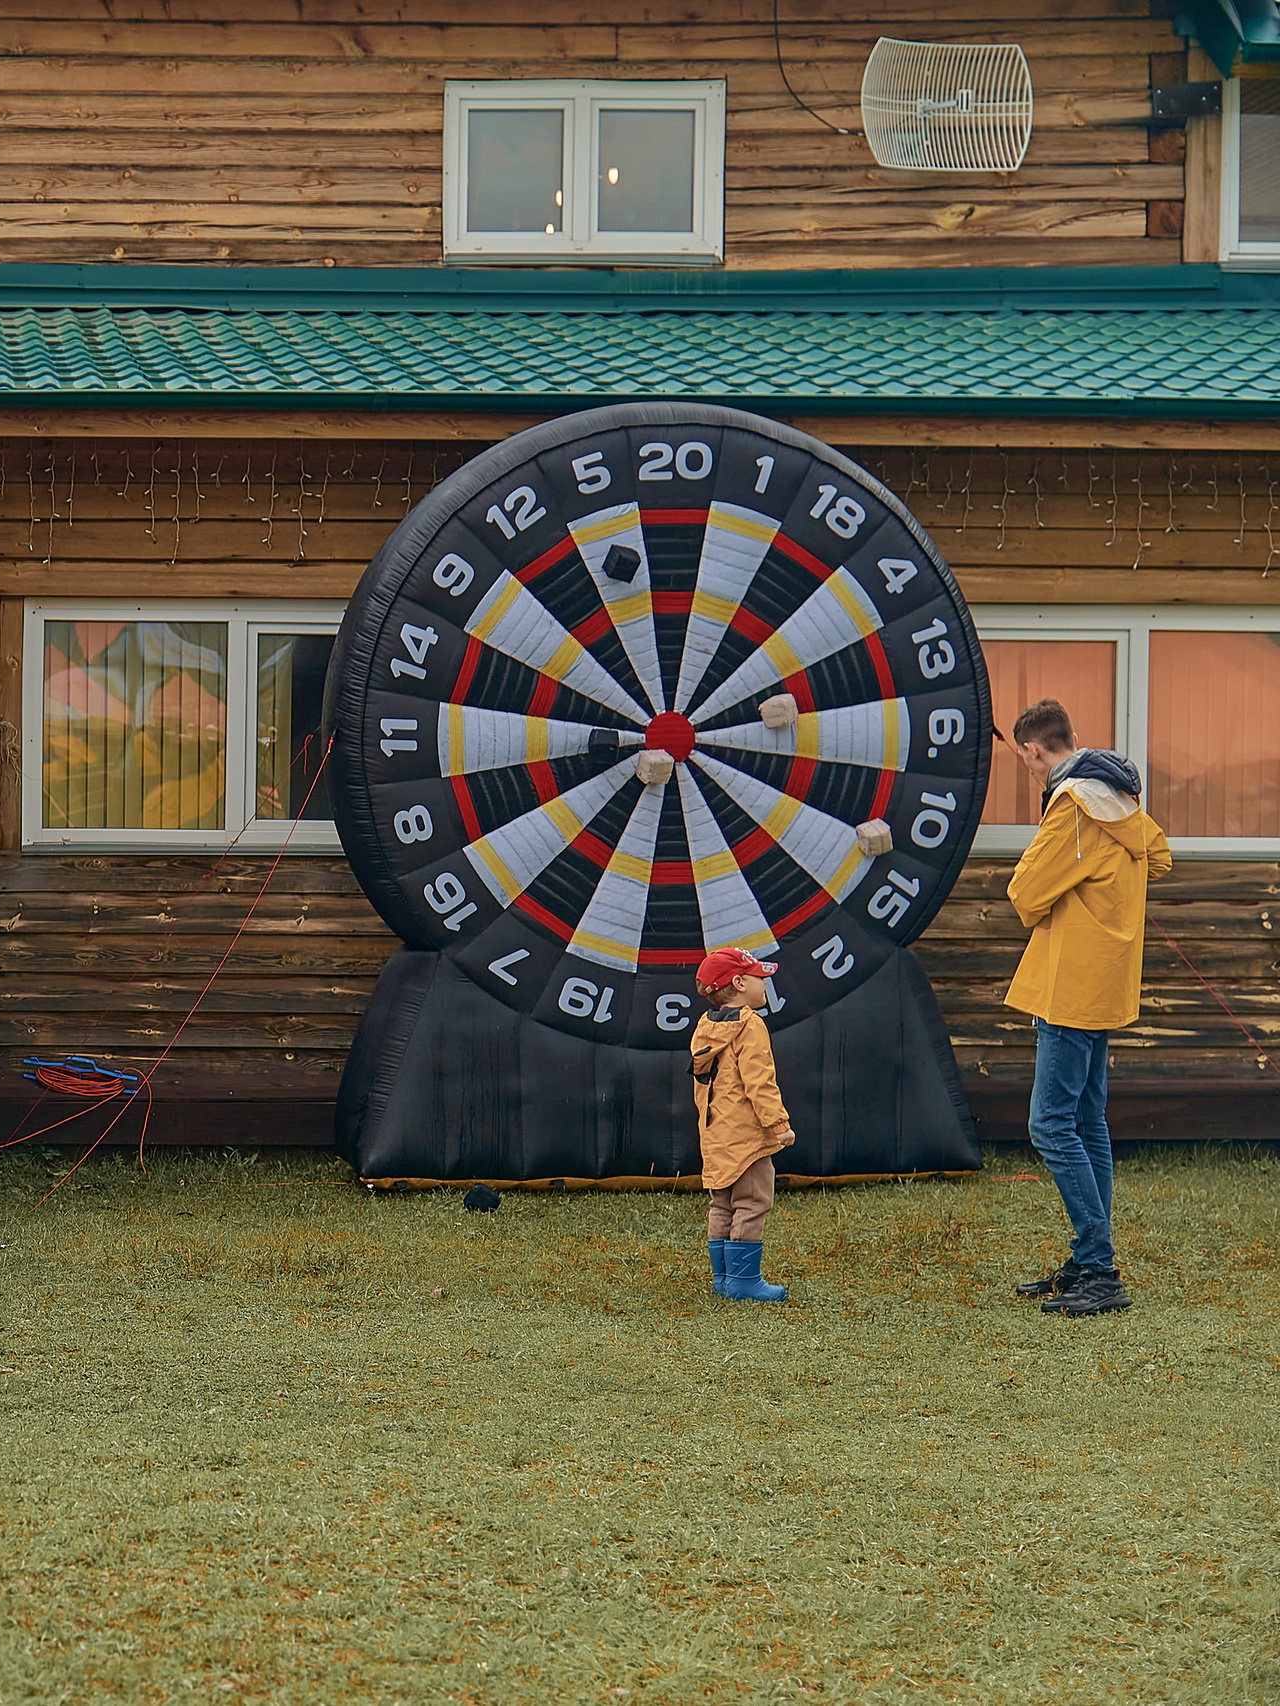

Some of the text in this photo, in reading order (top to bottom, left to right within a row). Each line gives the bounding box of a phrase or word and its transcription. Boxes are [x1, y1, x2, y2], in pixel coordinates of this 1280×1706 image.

[572, 451, 611, 494] 5
[638, 441, 713, 481] 20
[754, 455, 775, 494] 1
[486, 486, 547, 540] 12
[810, 483, 867, 539] 18
[433, 552, 475, 597] 9
[877, 558, 918, 594] 4
[390, 623, 439, 680] 14
[911, 617, 955, 679] 13
[380, 718, 418, 758] 11
[393, 804, 433, 844] 8
[910, 791, 956, 848] 10
[423, 871, 479, 932] 16
[867, 868, 920, 928] 15
[488, 948, 530, 986] 7
[812, 934, 854, 979] 2
[558, 977, 615, 1023] 19
[655, 993, 691, 1031] 3
